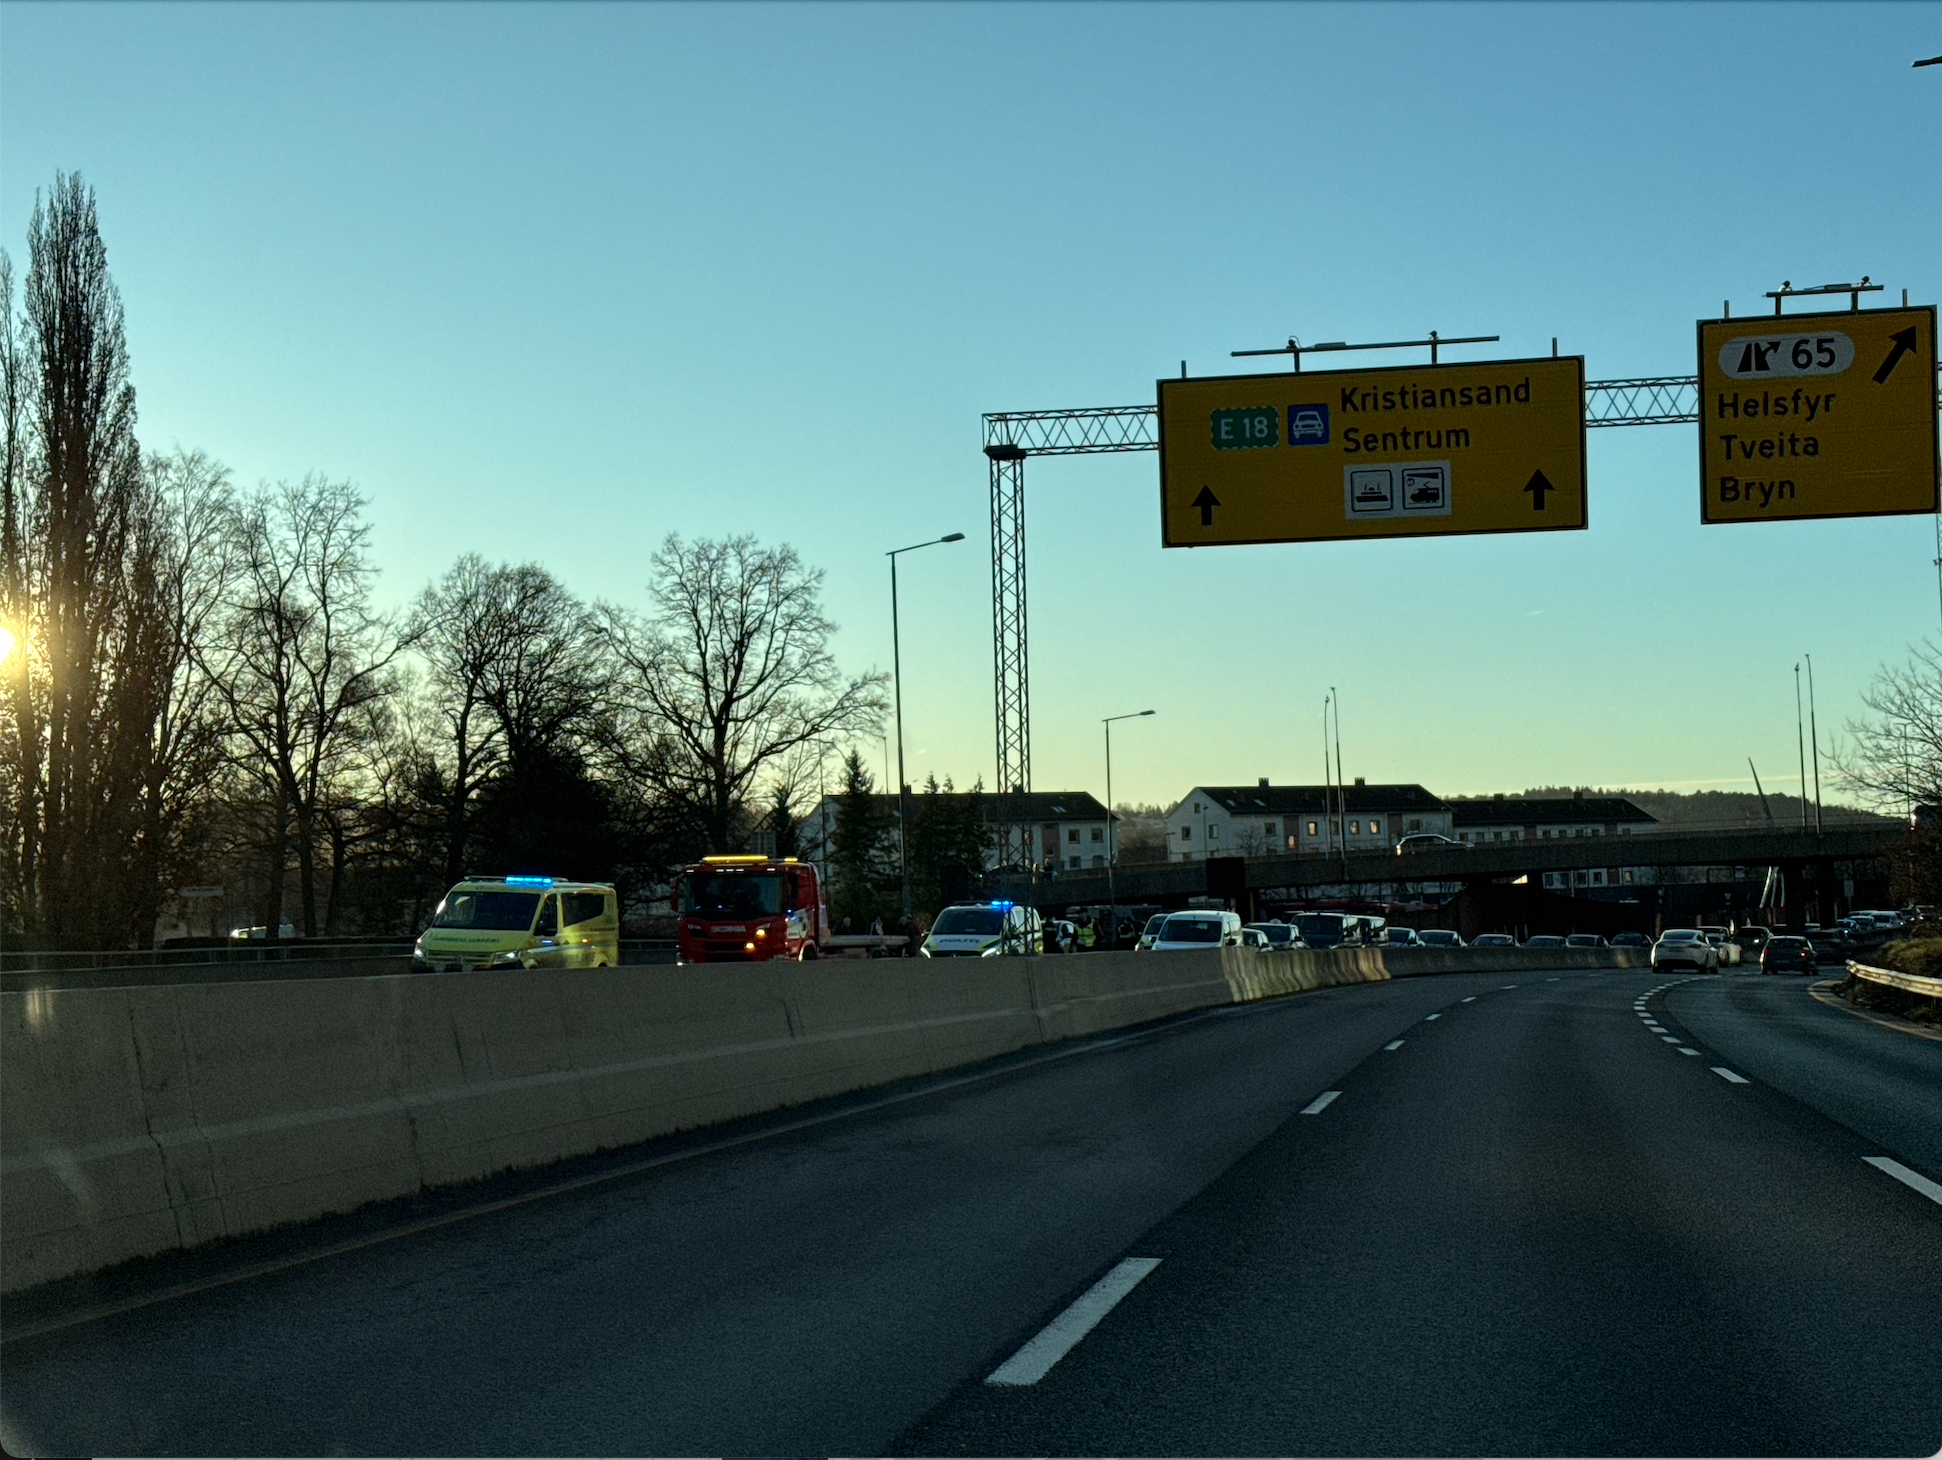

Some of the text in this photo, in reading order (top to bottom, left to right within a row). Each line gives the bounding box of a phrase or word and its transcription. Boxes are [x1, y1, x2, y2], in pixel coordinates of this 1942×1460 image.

[1791, 338, 1836, 370] 65
[1341, 377, 1531, 413] Kristiansand
[1718, 389, 1836, 422] Helsfyr
[1220, 416, 1269, 440] E 18
[1343, 425, 1471, 453] Sentrum
[1720, 431, 1820, 461] Tveita
[1720, 476, 1796, 508] Bryn
[710, 925, 747, 934] SCANIA
